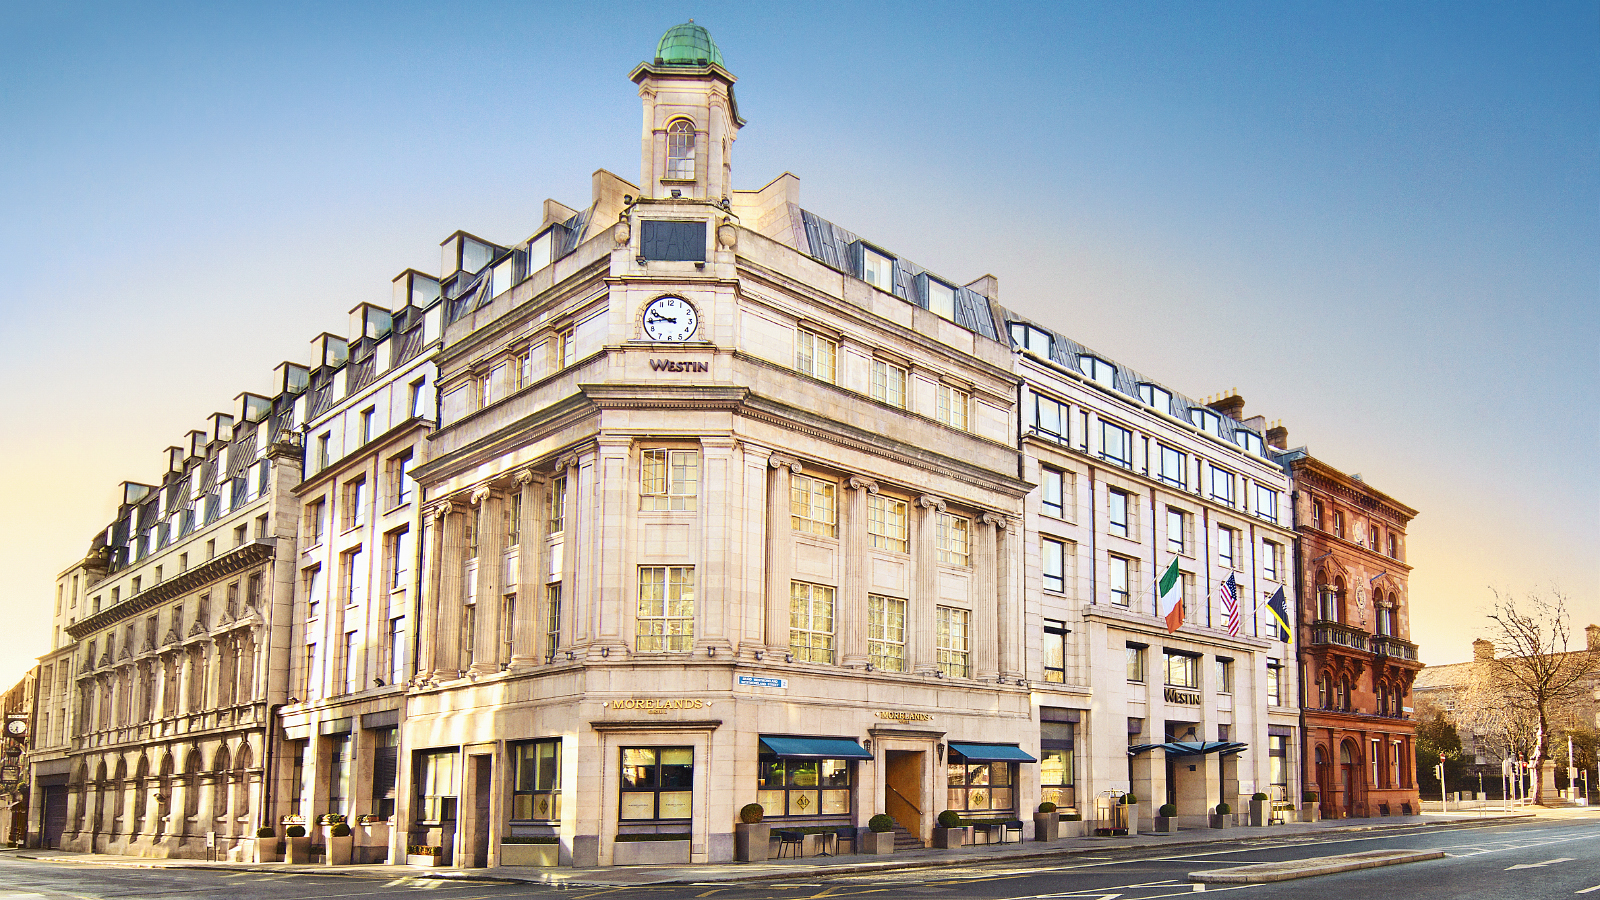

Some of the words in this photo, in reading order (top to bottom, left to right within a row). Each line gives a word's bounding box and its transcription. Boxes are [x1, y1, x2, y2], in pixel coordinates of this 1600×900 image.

[649, 359, 709, 372] WESTIN
[1164, 688, 1201, 705] WESTIN
[612, 699, 703, 709] MORELANDS
[880, 711, 929, 721] MORELANDS
